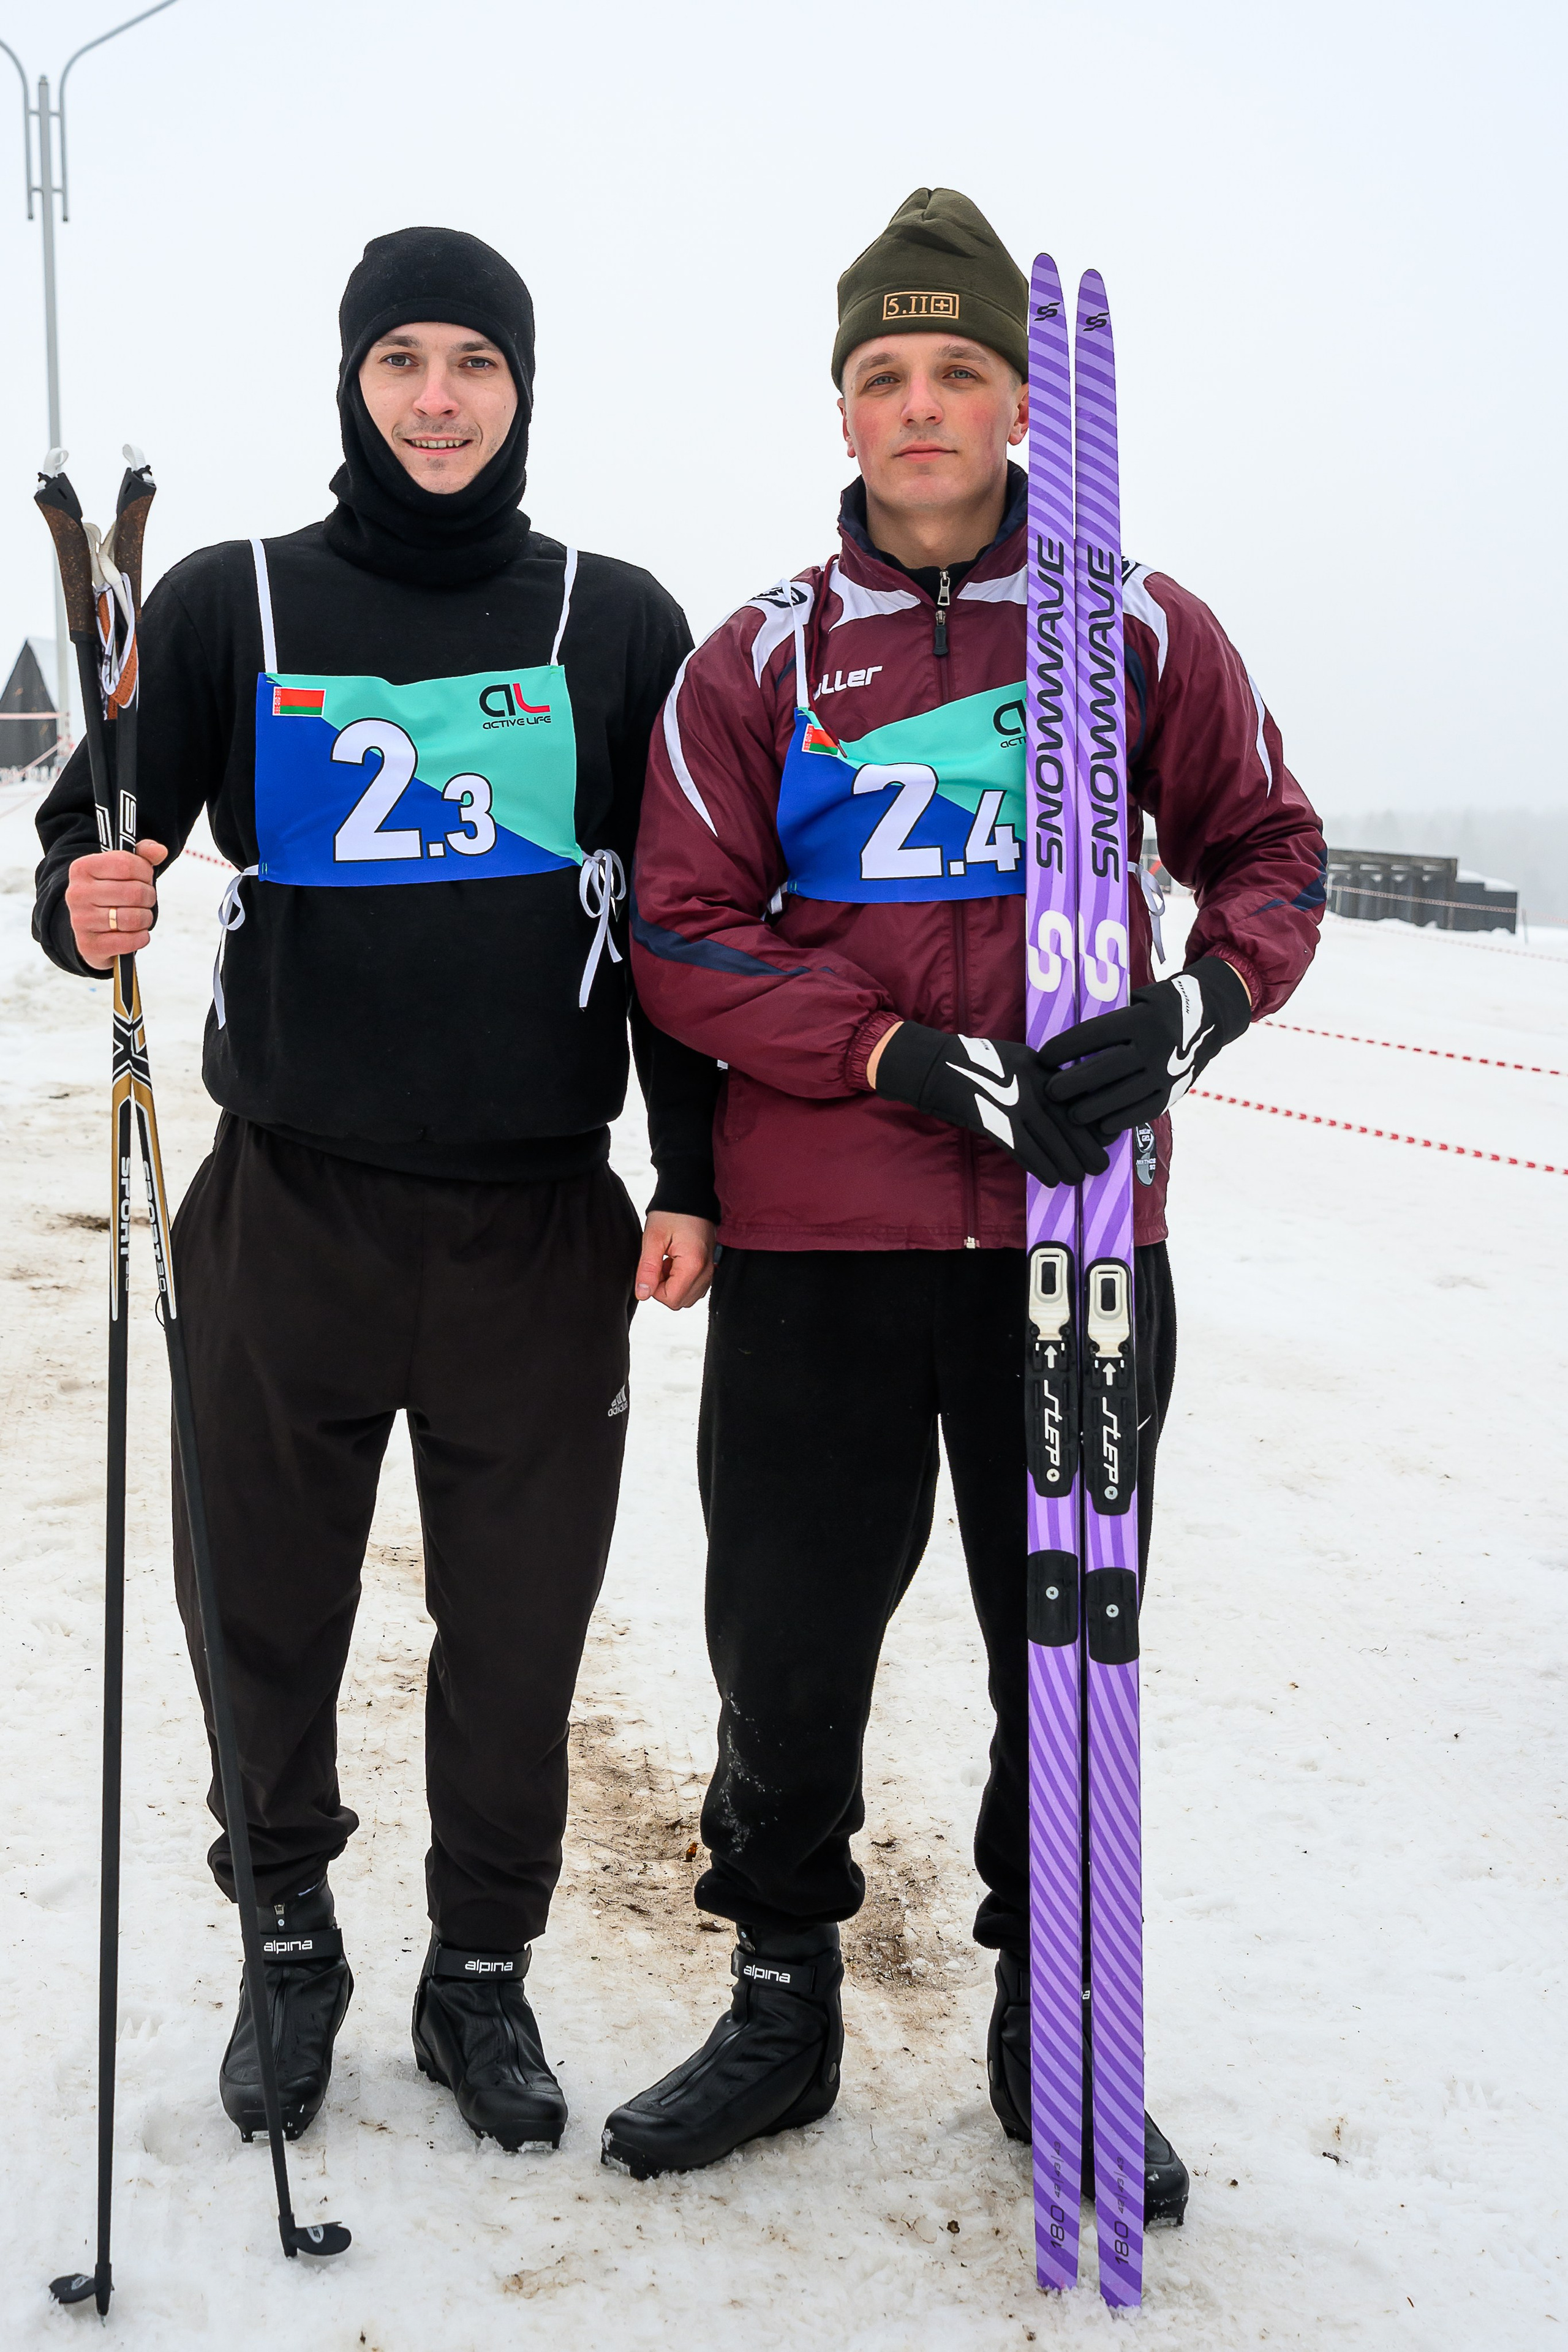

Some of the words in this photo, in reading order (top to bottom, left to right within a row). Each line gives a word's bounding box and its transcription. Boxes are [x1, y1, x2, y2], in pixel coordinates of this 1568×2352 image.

[483, 718, 525, 729] ACTIVE
[526, 715, 551, 725] LIFE
[1036, 533, 1065, 874] SNOWWAVE
[1087, 543, 1120, 883] SNOWWAVE
[330, 717, 497, 864] 2.3
[851, 762, 1022, 881] 2.4
[263, 1939, 313, 1954] alpina
[465, 1959, 513, 1973] alpina
[743, 1964, 791, 1984] alpina
[1050, 2204, 1065, 2248] 180
[1114, 2220, 1129, 2265] 180
